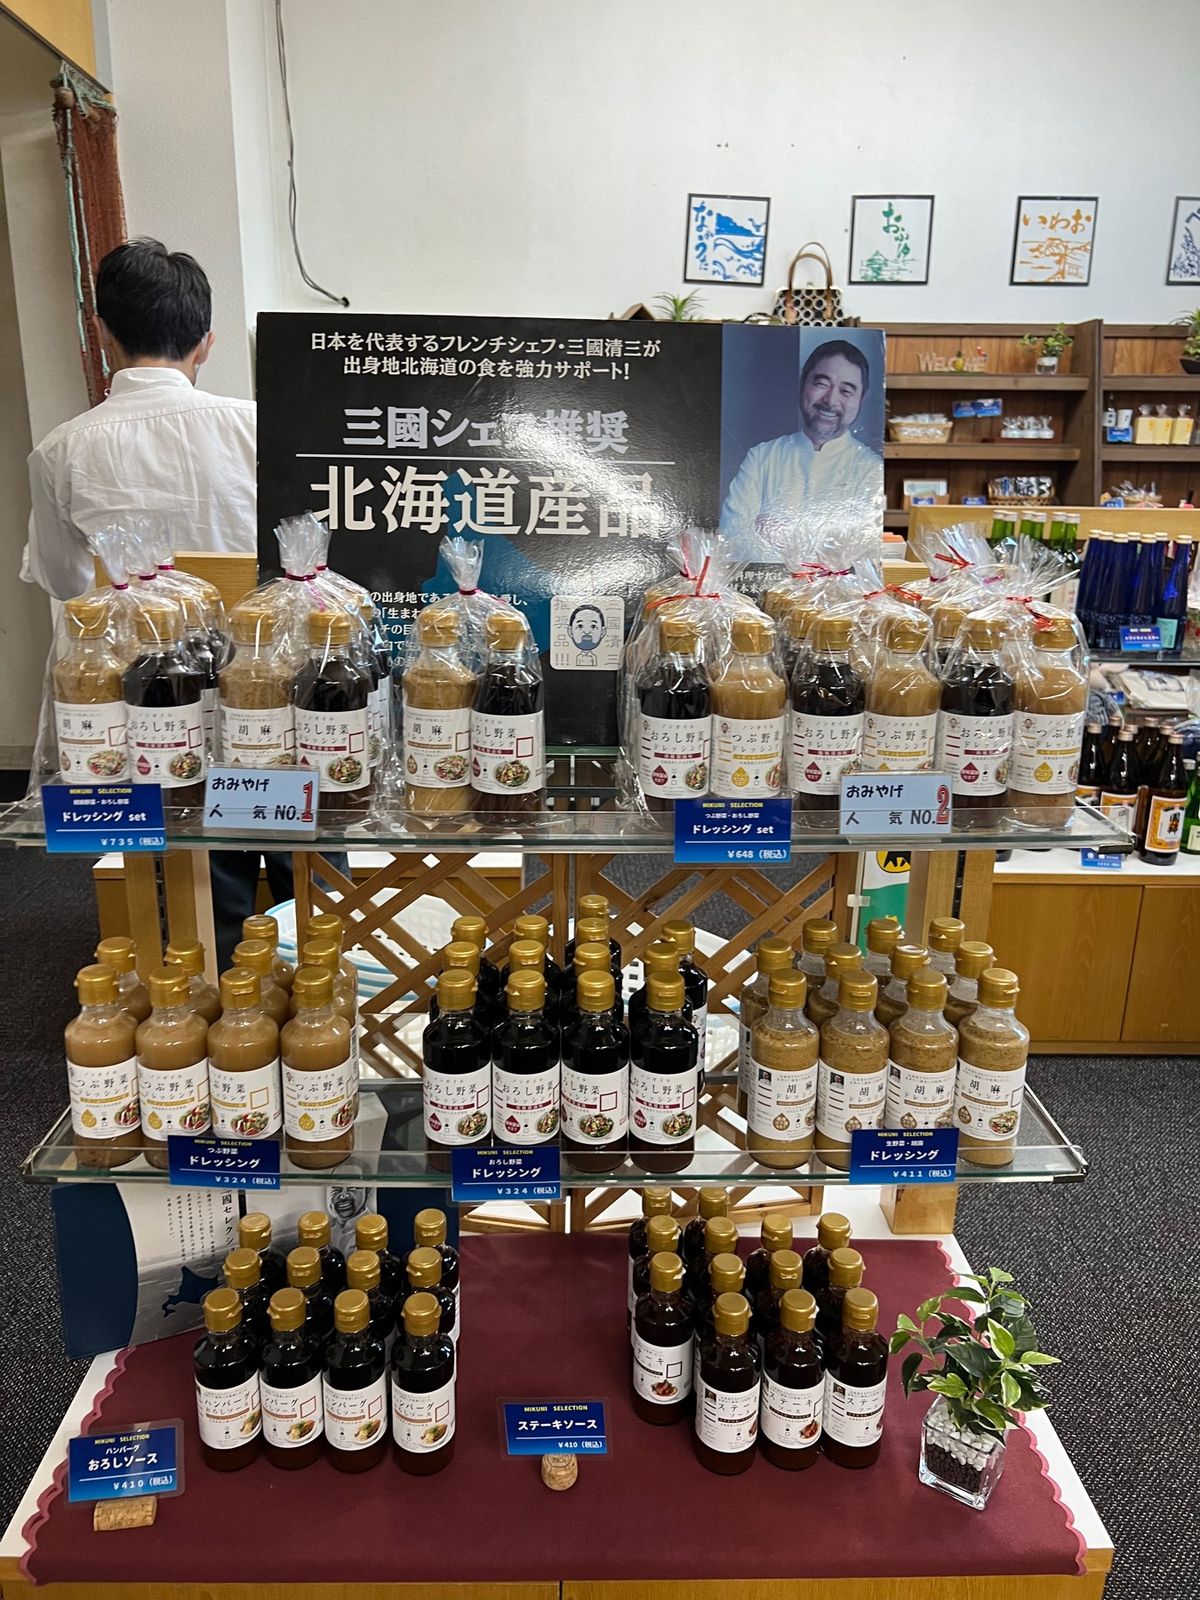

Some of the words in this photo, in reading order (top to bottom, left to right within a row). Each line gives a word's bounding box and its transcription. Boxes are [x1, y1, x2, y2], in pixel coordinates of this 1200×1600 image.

[311, 332, 661, 358] 日本を代表するフレンチシェフ・三國清三が
[343, 356, 630, 380] 出身地北海道の食を強力サポート!
[343, 406, 629, 454] 三國シェ推奨
[238, 724, 272, 736] 胡麻
[413, 722, 442, 735] 胡麻
[876, 728, 928, 741] つぶ野菜
[651, 730, 704, 744] おろし野菜
[212, 777, 270, 792] おみやげ
[846, 785, 904, 798] おみやげ
[62, 811, 123, 822] ドレッシング
[128, 813, 146, 822] set
[209, 804, 267, 820] 人気
[845, 811, 902, 825] 人気
[692, 824, 752, 834] ドレッシング
[756, 826, 774, 834] set
[101, 838, 133, 846] ¥735
[727, 850, 754, 859] ¥648
[295, 1076, 344, 1092] つぶ野菜
[914, 1085, 944, 1095] 胡麻
[970, 1080, 1001, 1094] 胡麻
[870, 1149, 940, 1161] ドレッシング
[190, 1156, 260, 1168] ドレッシング
[472, 1166, 542, 1178] ドレッシング
[928, 1169, 952, 1177] (税込)
[215, 1176, 247, 1184] ¥324
[252, 1177, 276, 1185] (税込)
[533, 1186, 557, 1195] (税込)
[518, 1419, 597, 1430] ステーキソース
[119, 1434, 150, 1442] SELECTION
[105, 1444, 140, 1455] ハンバーグ
[88, 1453, 158, 1471] おろしソース
[113, 1481, 144, 1490] ¥410
